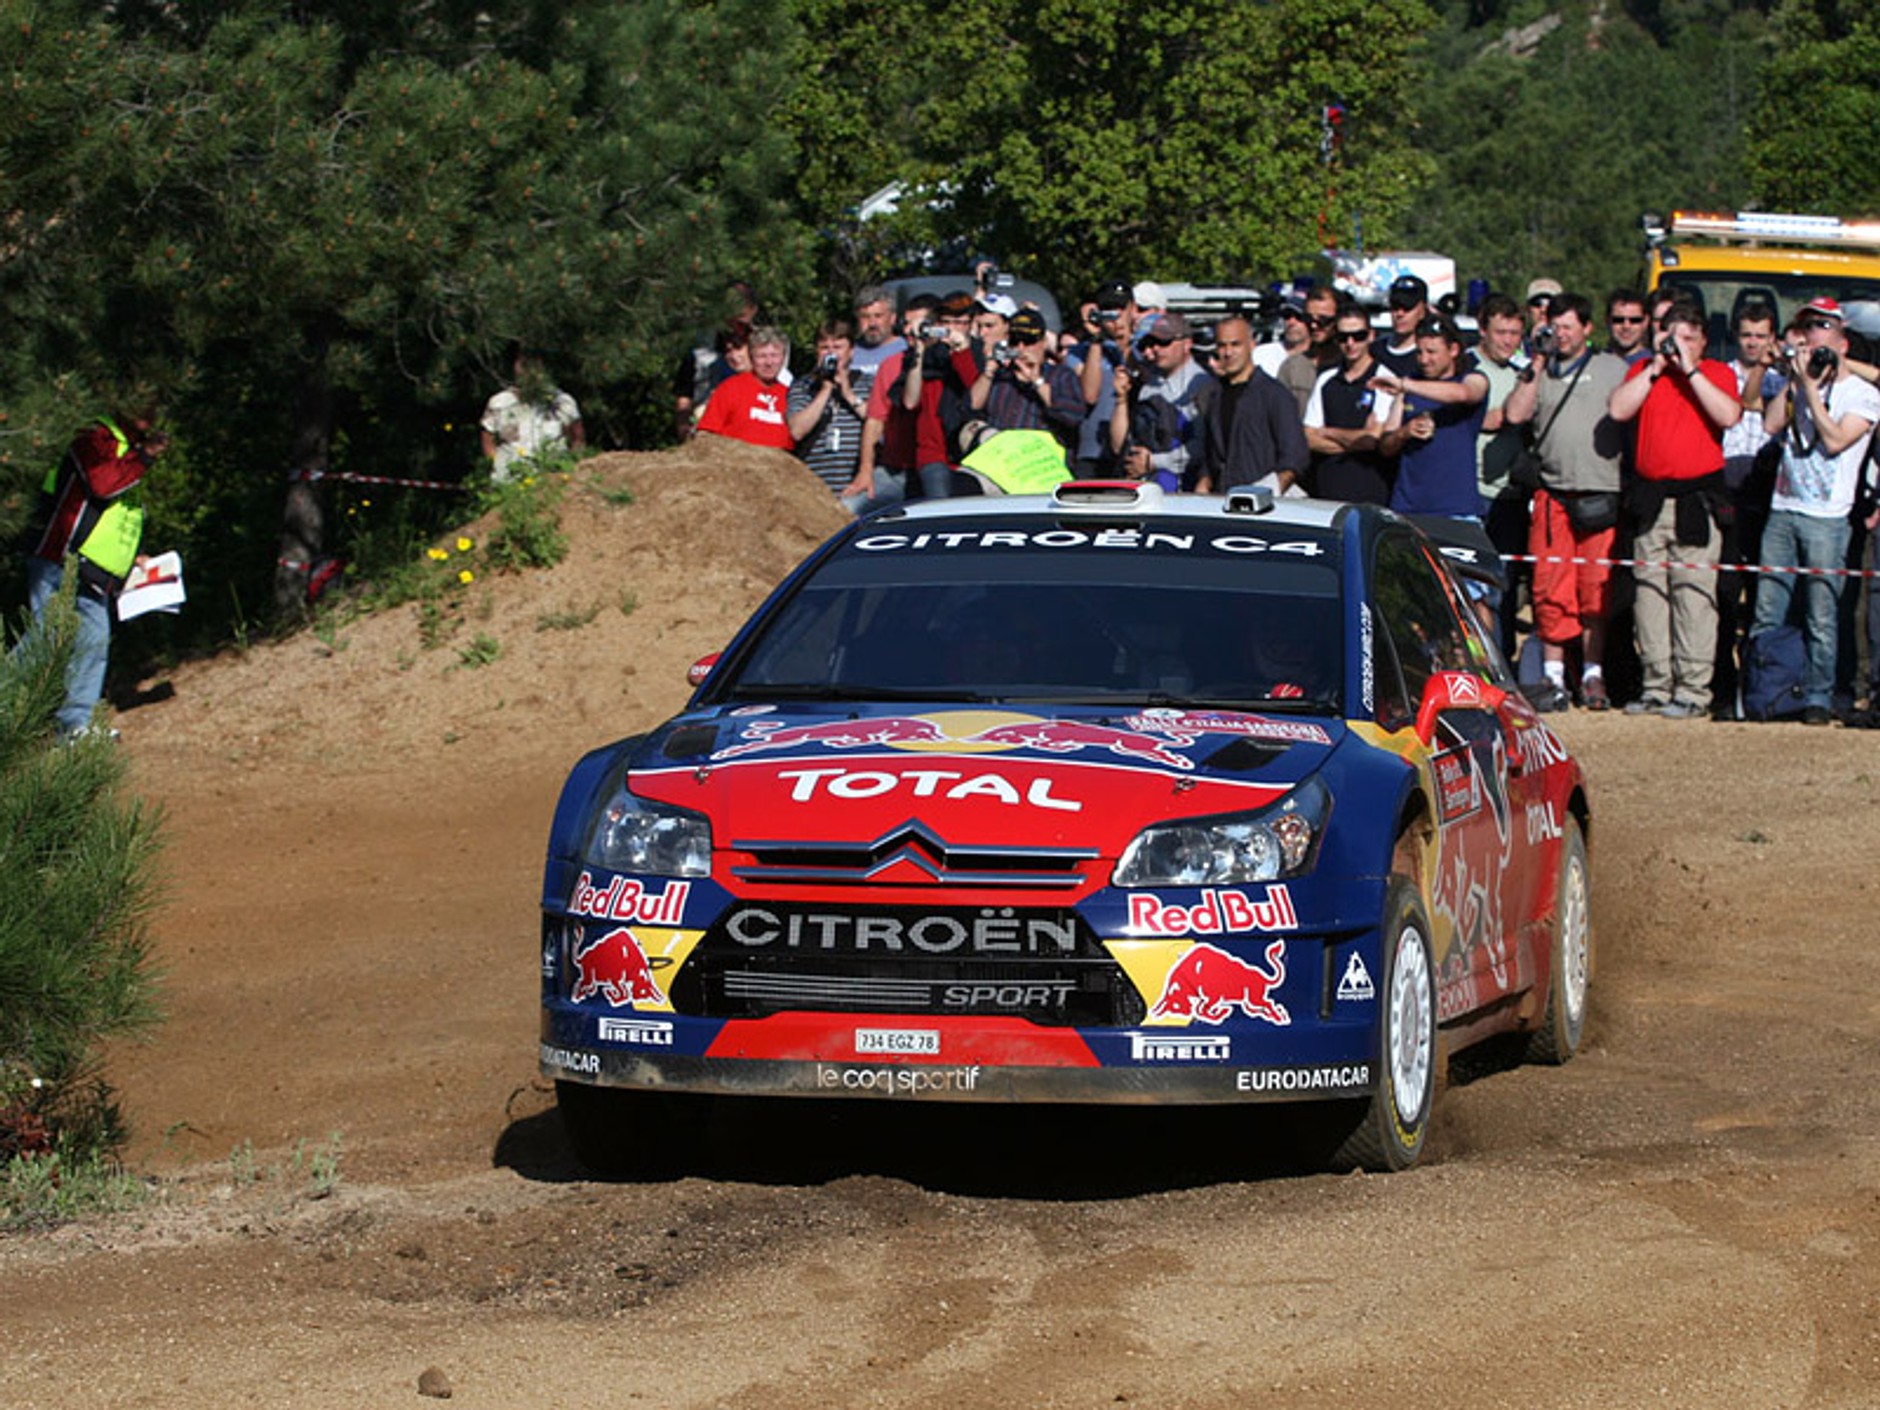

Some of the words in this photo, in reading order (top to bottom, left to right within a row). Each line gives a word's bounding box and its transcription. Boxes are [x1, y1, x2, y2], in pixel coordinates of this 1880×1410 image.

[854, 528, 1195, 551] CITROËN
[1210, 537, 1324, 556] C4
[778, 768, 1082, 812] TOTAL
[568, 872, 619, 916] Red
[613, 876, 690, 924] Bull
[1129, 890, 1218, 935] Red
[1221, 884, 1297, 932] Bull
[725, 906, 1077, 953] CITROËN
[943, 984, 1075, 1008] SPORT
[598, 1017, 674, 1045] PIRELLI
[862, 1034, 883, 1047] 734
[888, 1034, 914, 1049] EGZ
[919, 1036, 934, 1049] 78
[1131, 1036, 1230, 1061] PIRELLI
[817, 1064, 838, 1088] le
[843, 1069, 894, 1094] coq
[897, 1066, 980, 1095] sportif
[1236, 1067, 1371, 1091] EURODATACAR
